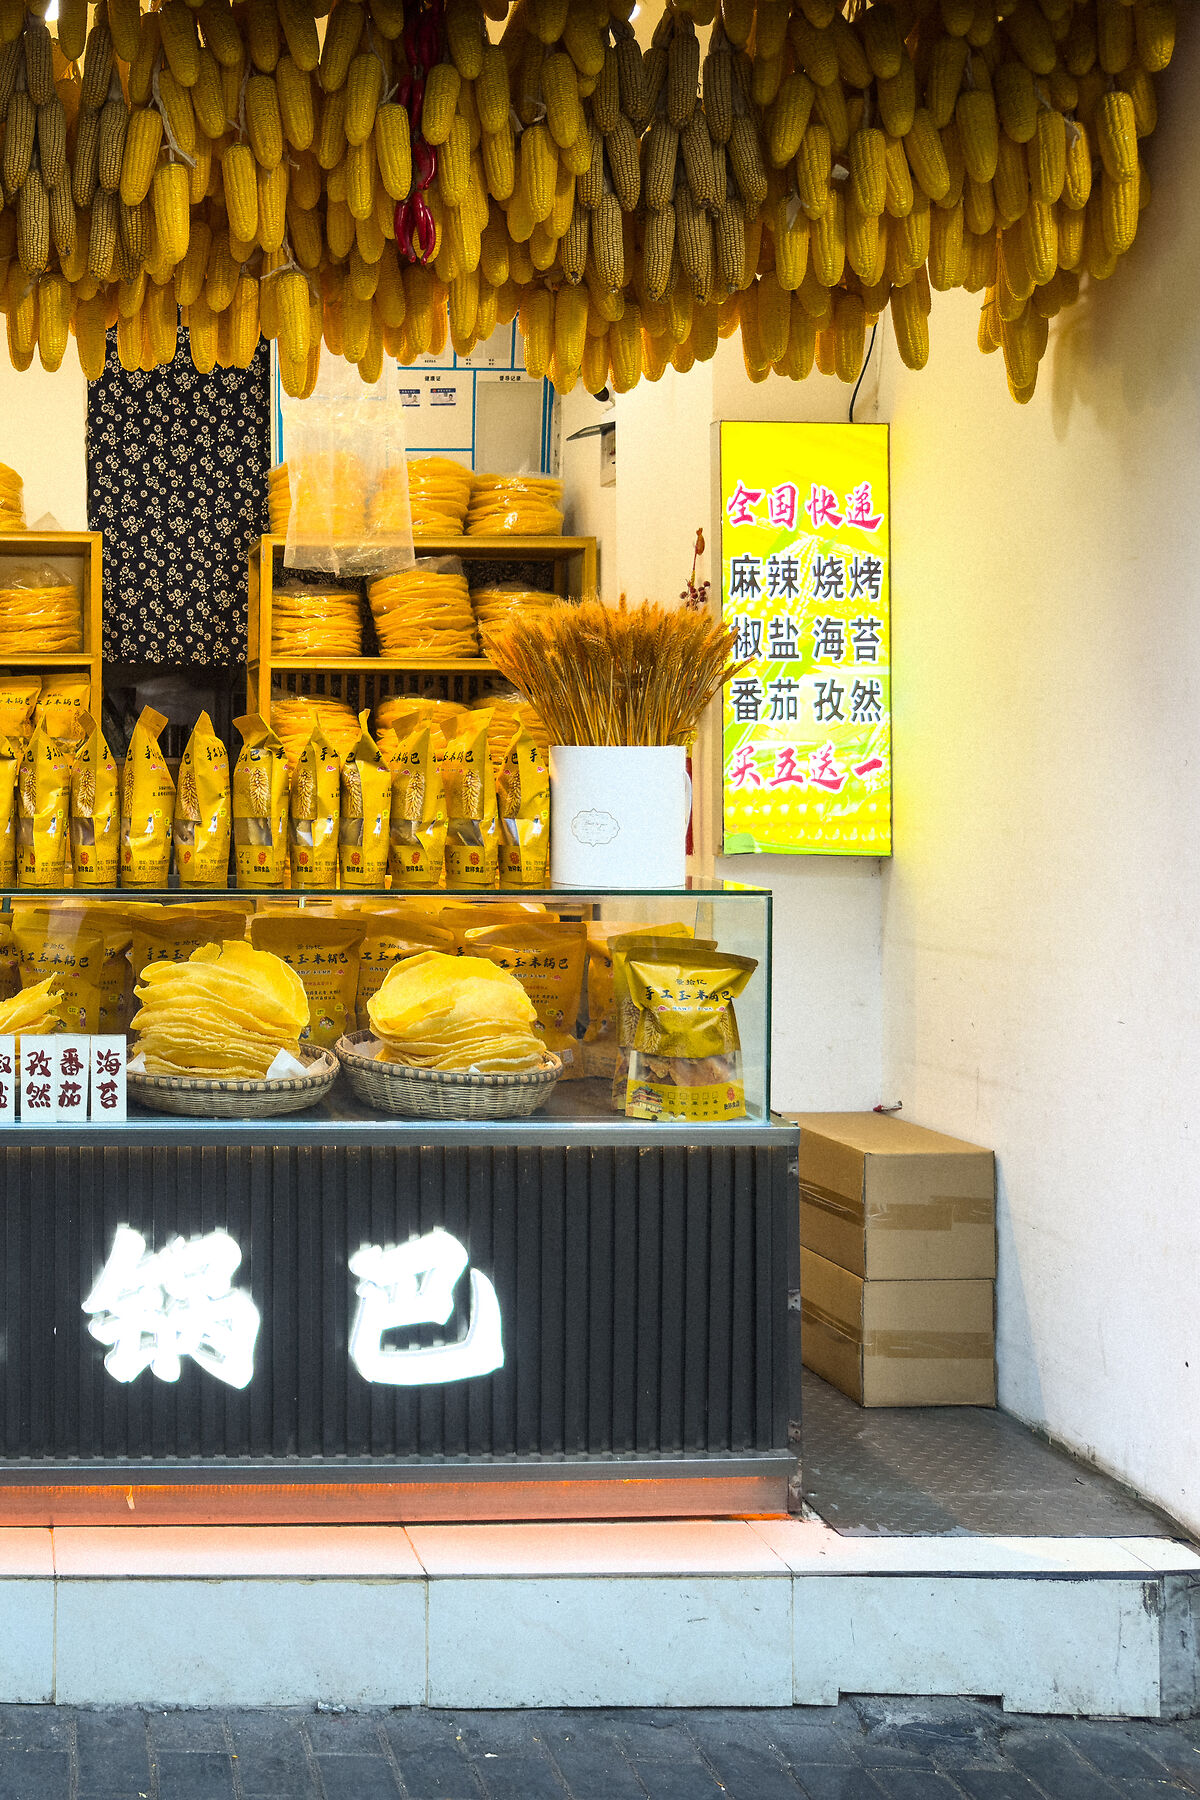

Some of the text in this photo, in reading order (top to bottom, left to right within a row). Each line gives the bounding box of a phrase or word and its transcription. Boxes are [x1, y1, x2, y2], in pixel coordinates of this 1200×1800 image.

[727, 482, 883, 529] 全国快递
[730, 554, 883, 600] 麻辣 烧烤
[731, 616, 882, 662] 椒盐 海苔
[730, 678, 882, 723] 番茄 孜然
[730, 744, 883, 791] 买五送一
[645, 986, 735, 1001] 手工玉米锅巴
[25, 1049, 52, 1109] 孜然
[57, 1047, 84, 1109] 番茄
[96, 1048, 122, 1109] 海苔
